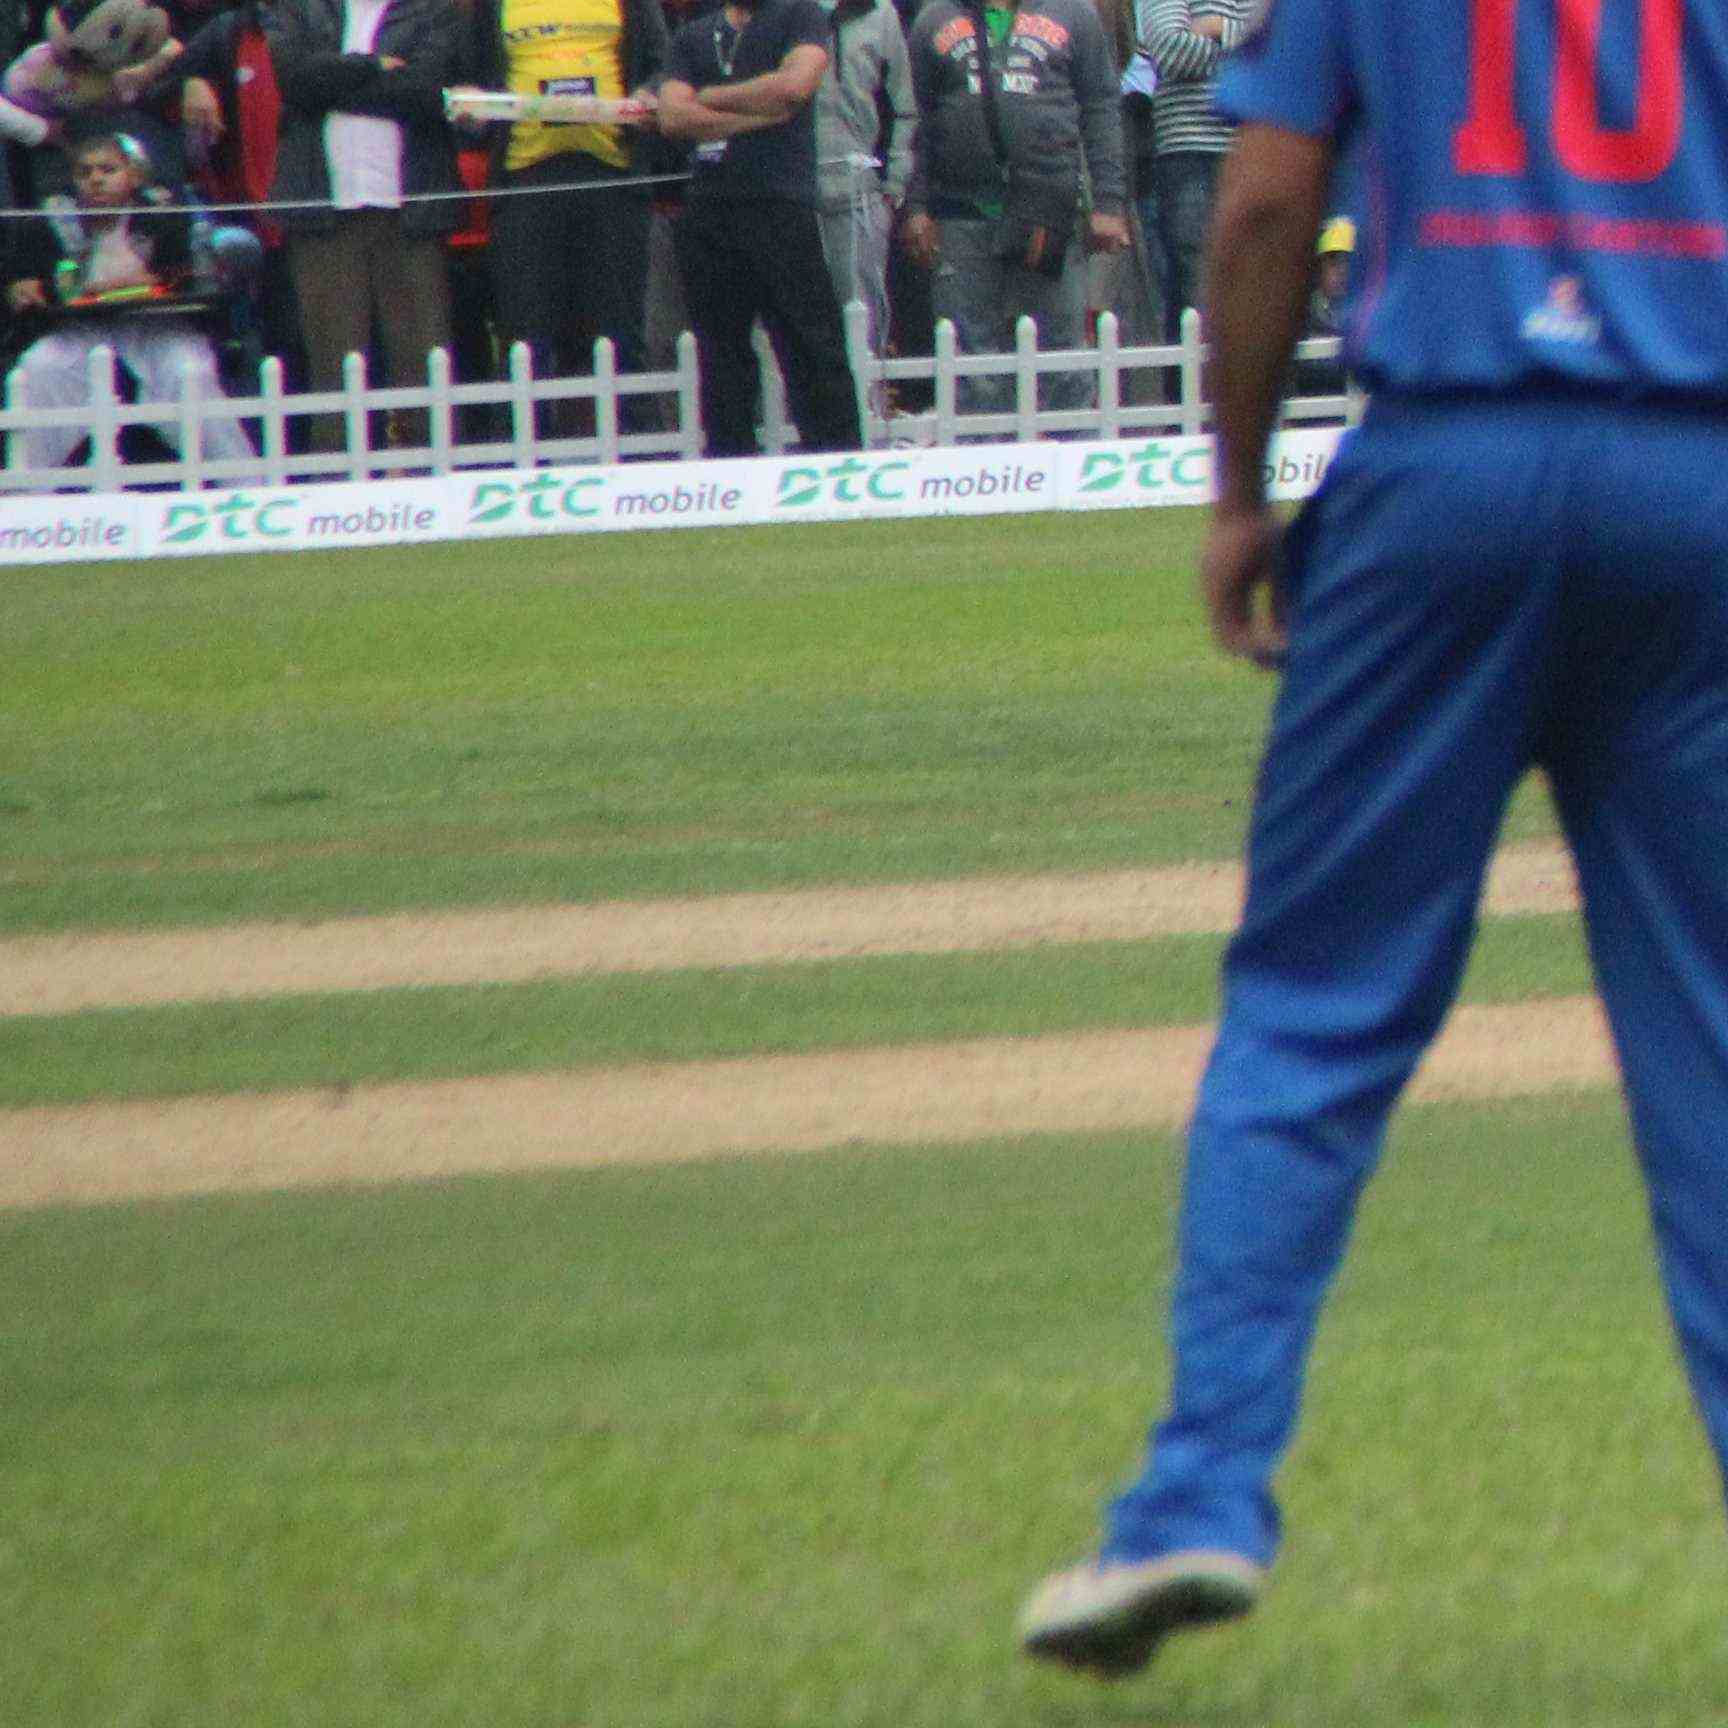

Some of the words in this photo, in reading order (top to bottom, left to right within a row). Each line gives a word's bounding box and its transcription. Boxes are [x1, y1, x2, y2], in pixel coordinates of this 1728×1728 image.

[919, 464, 1047, 499] mobile
[613, 482, 742, 516] mobile
[307, 503, 437, 536] mobile
